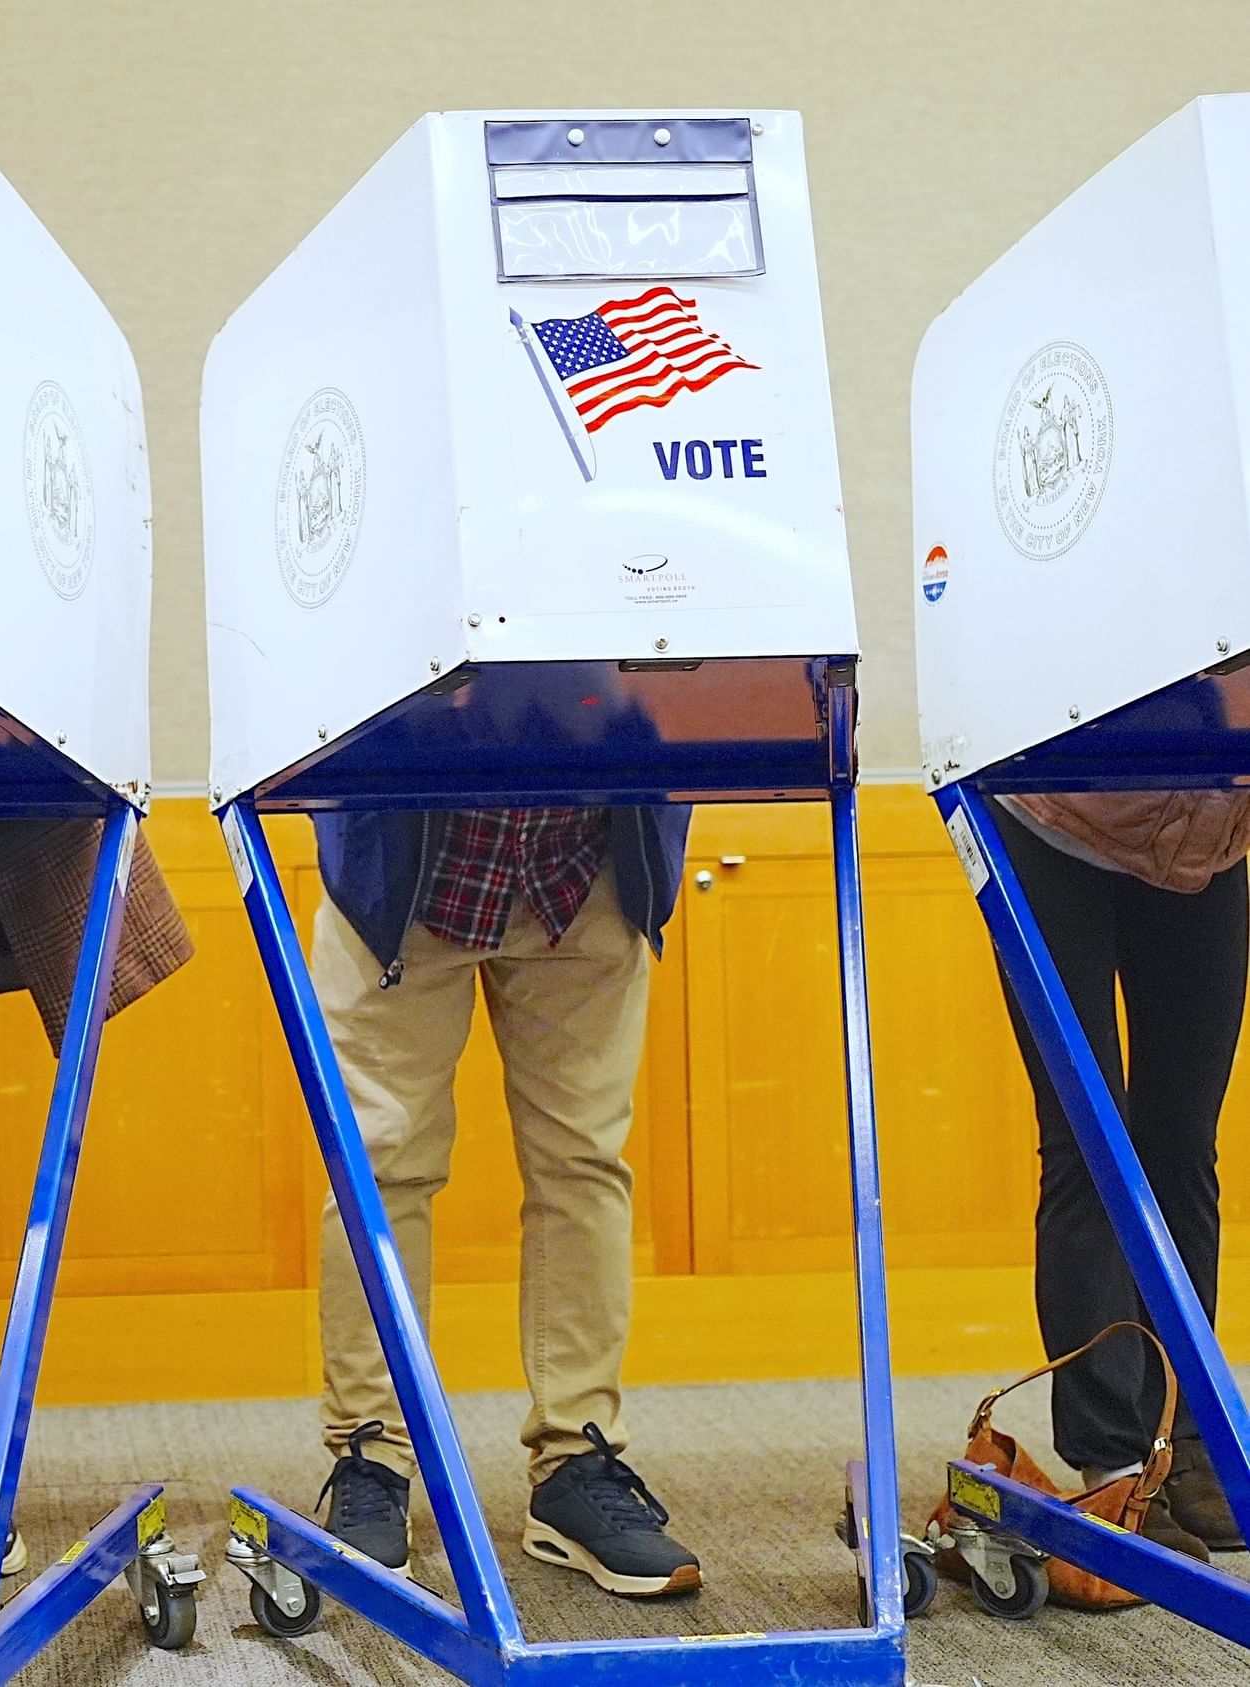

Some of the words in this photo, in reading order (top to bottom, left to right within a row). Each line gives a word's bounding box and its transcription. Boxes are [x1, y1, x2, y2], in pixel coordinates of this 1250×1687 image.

[1022, 369, 1036, 389] OF
[1039, 351, 1098, 395] ELECTIONS
[653, 439, 766, 480] VOTE
[1006, 506, 1024, 540] THE
[1026, 534, 1053, 550] CITY
[1056, 528, 1071, 545] OF
[1073, 480, 1098, 529] NEW
[1094, 414, 1108, 475] YORK
[332, 532, 351, 577] NEW
[350, 469, 362, 527] YORK
[618, 573, 687, 584] SMARTPOLL
